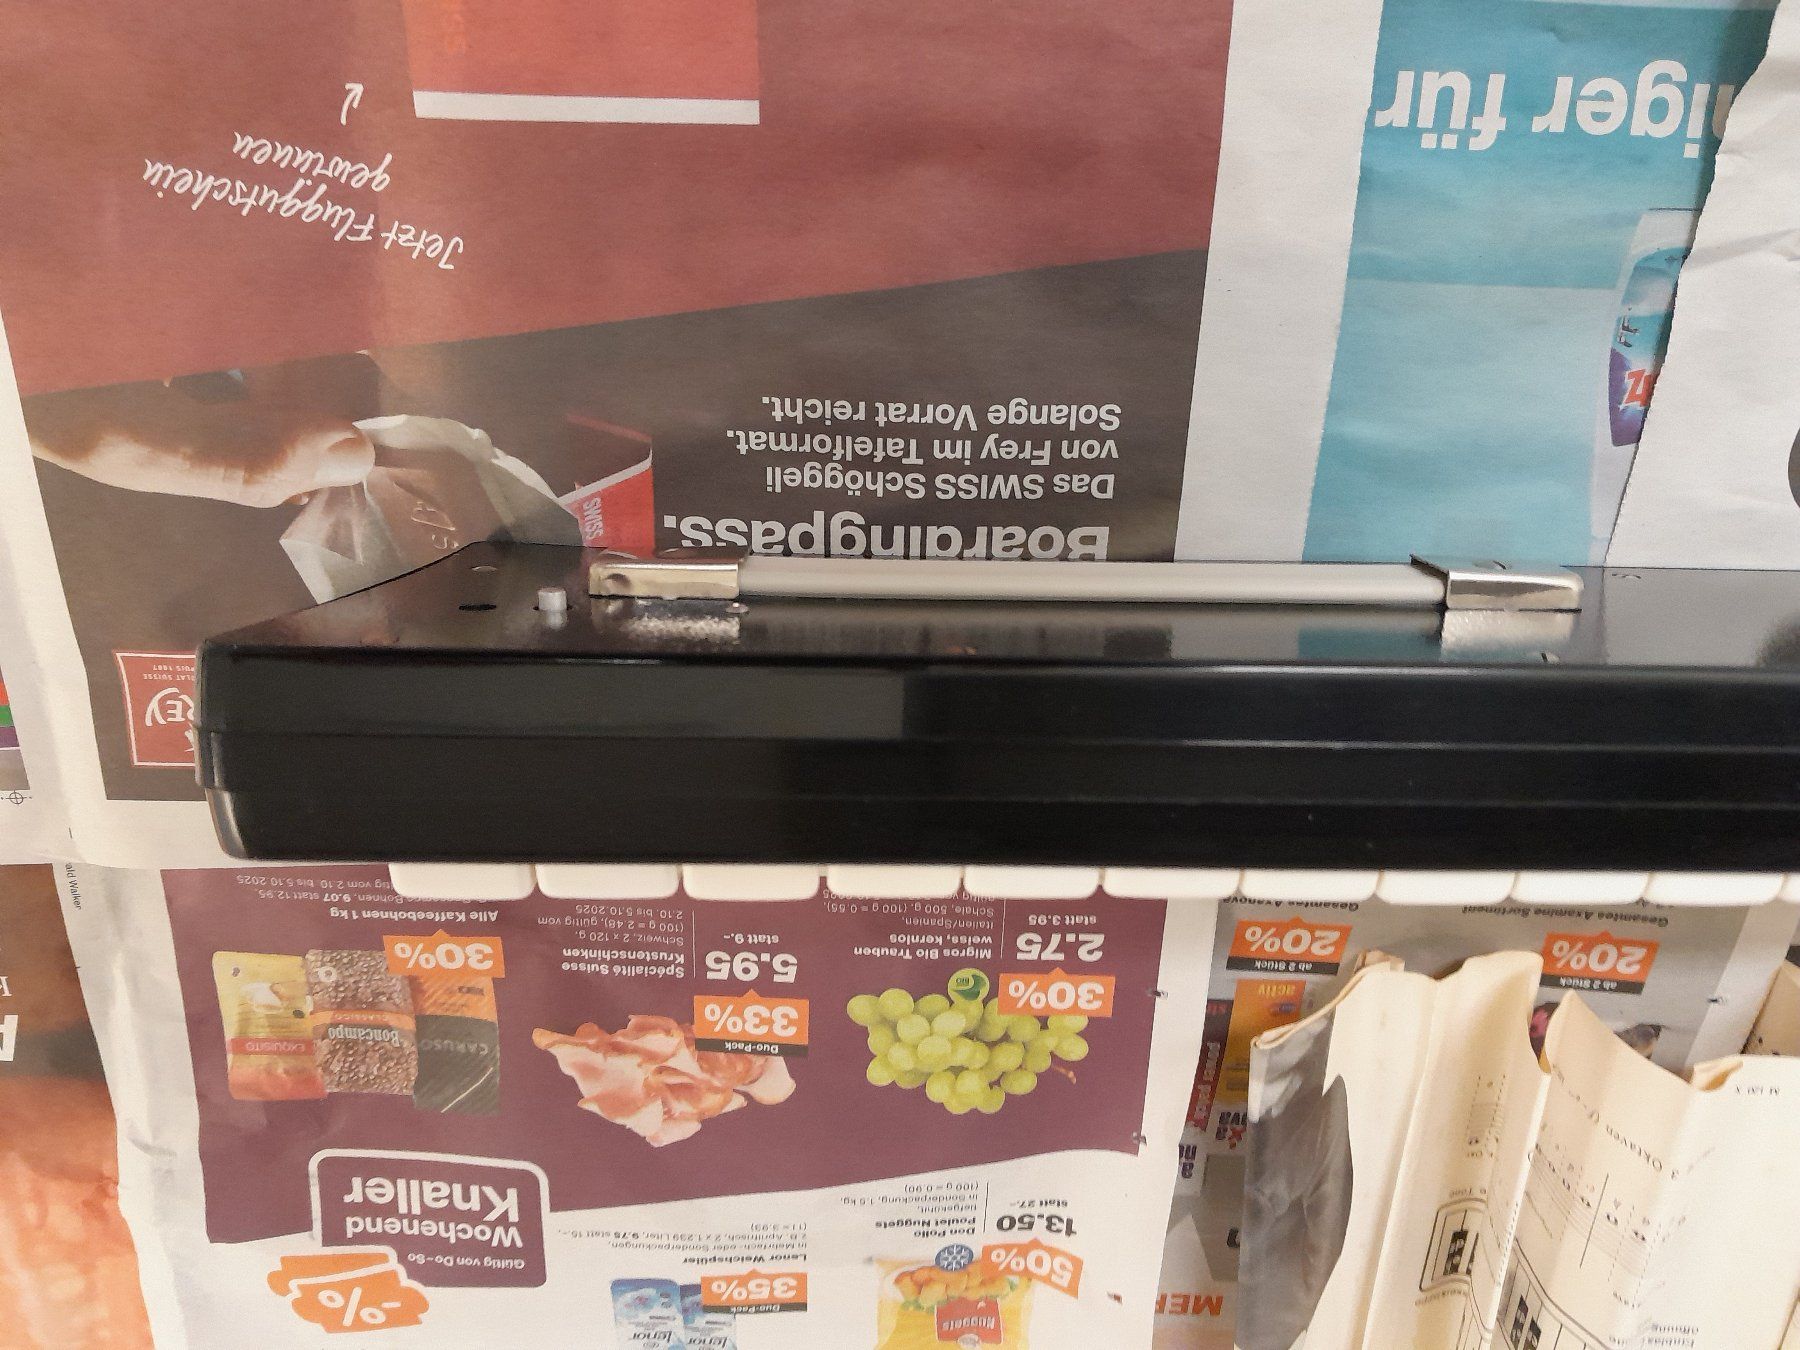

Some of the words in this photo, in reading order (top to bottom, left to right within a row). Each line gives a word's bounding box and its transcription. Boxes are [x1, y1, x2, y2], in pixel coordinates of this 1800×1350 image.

[1375, 70, 1507, 150] für
[233, 131, 393, 193] gewinnen
[143, 158, 375, 242] Fluggutschein
[381, 220, 463, 270] Jetzt
[761, 396, 866, 425] reicht.
[875, 402, 978, 432] Vorrat
[987, 397, 1122, 431] Solange
[726, 430, 924, 465] Tafelformat.
[933, 439, 971, 466] im
[980, 433, 1051, 465] Frey
[1060, 439, 1119, 460] von
[766, 462, 926, 499] Schöggeli
[934, 474, 1044, 499] SWISS
[1052, 474, 1115, 499] Das
[144, 687, 195, 727] REY
[68, 879, 82, 910] Walker
[293, 891, 320, 901] statt
[323, 892, 351, 903] 9.07
[329, 906, 348, 919] kg
[351, 910, 359, 920] 1
[361, 910, 466, 922] Kaffeebohnen
[469, 910, 499, 922] Alle
[636, 907, 653, 917] bis
[1028, 914, 1061, 925] 3.95
[1064, 914, 1097, 925] statt
[536, 916, 561, 925] vom
[564, 915, 597, 927] gültig
[648, 920, 656, 931] g
[659, 922, 684, 933] (100
[588, 932, 609, 942] 120
[622, 933, 630, 943] 2
[747, 934, 779, 945] statt
[889, 933, 943, 945] kernlos
[1244, 926, 1340, 956] 20%
[853, 946, 912, 959] Trauben
[915, 948, 939, 959] Bio
[943, 946, 992, 959] Migros
[1016, 932, 1105, 962] 2.75
[393, 942, 495, 971] 30%
[562, 948, 685, 964] Krustenschinken
[1552, 940, 1647, 975] 20%
[561, 962, 609, 975] Suisse
[612, 964, 685, 979] Spécialité
[705, 950, 798, 984] 5.95
[1253, 959, 1286, 969] Stück
[1288, 961, 1297, 971] 2
[1299, 962, 1312, 972] ab
[1592, 979, 1601, 989] 2
[1602, 979, 1617, 990] ab
[1008, 980, 1105, 1010] 30%
[704, 1003, 799, 1037] 33%
[327, 1024, 401, 1047] Boncampo
[724, 1041, 779, 1054] Duo-Pack
[1604, 1124, 1663, 1173] Oktaven
[343, 1176, 520, 1223] Knaller
[345, 1216, 523, 1248] Wochenend
[996, 1213, 1077, 1238] 13.50
[456, 1257, 481, 1267] von
[484, 1257, 525, 1270] Gültig
[769, 1253, 807, 1262] Lenor
[990, 1248, 1073, 1288] 50%
[711, 1277, 798, 1301] 35%
[941, 1315, 995, 1330] Nuggets
